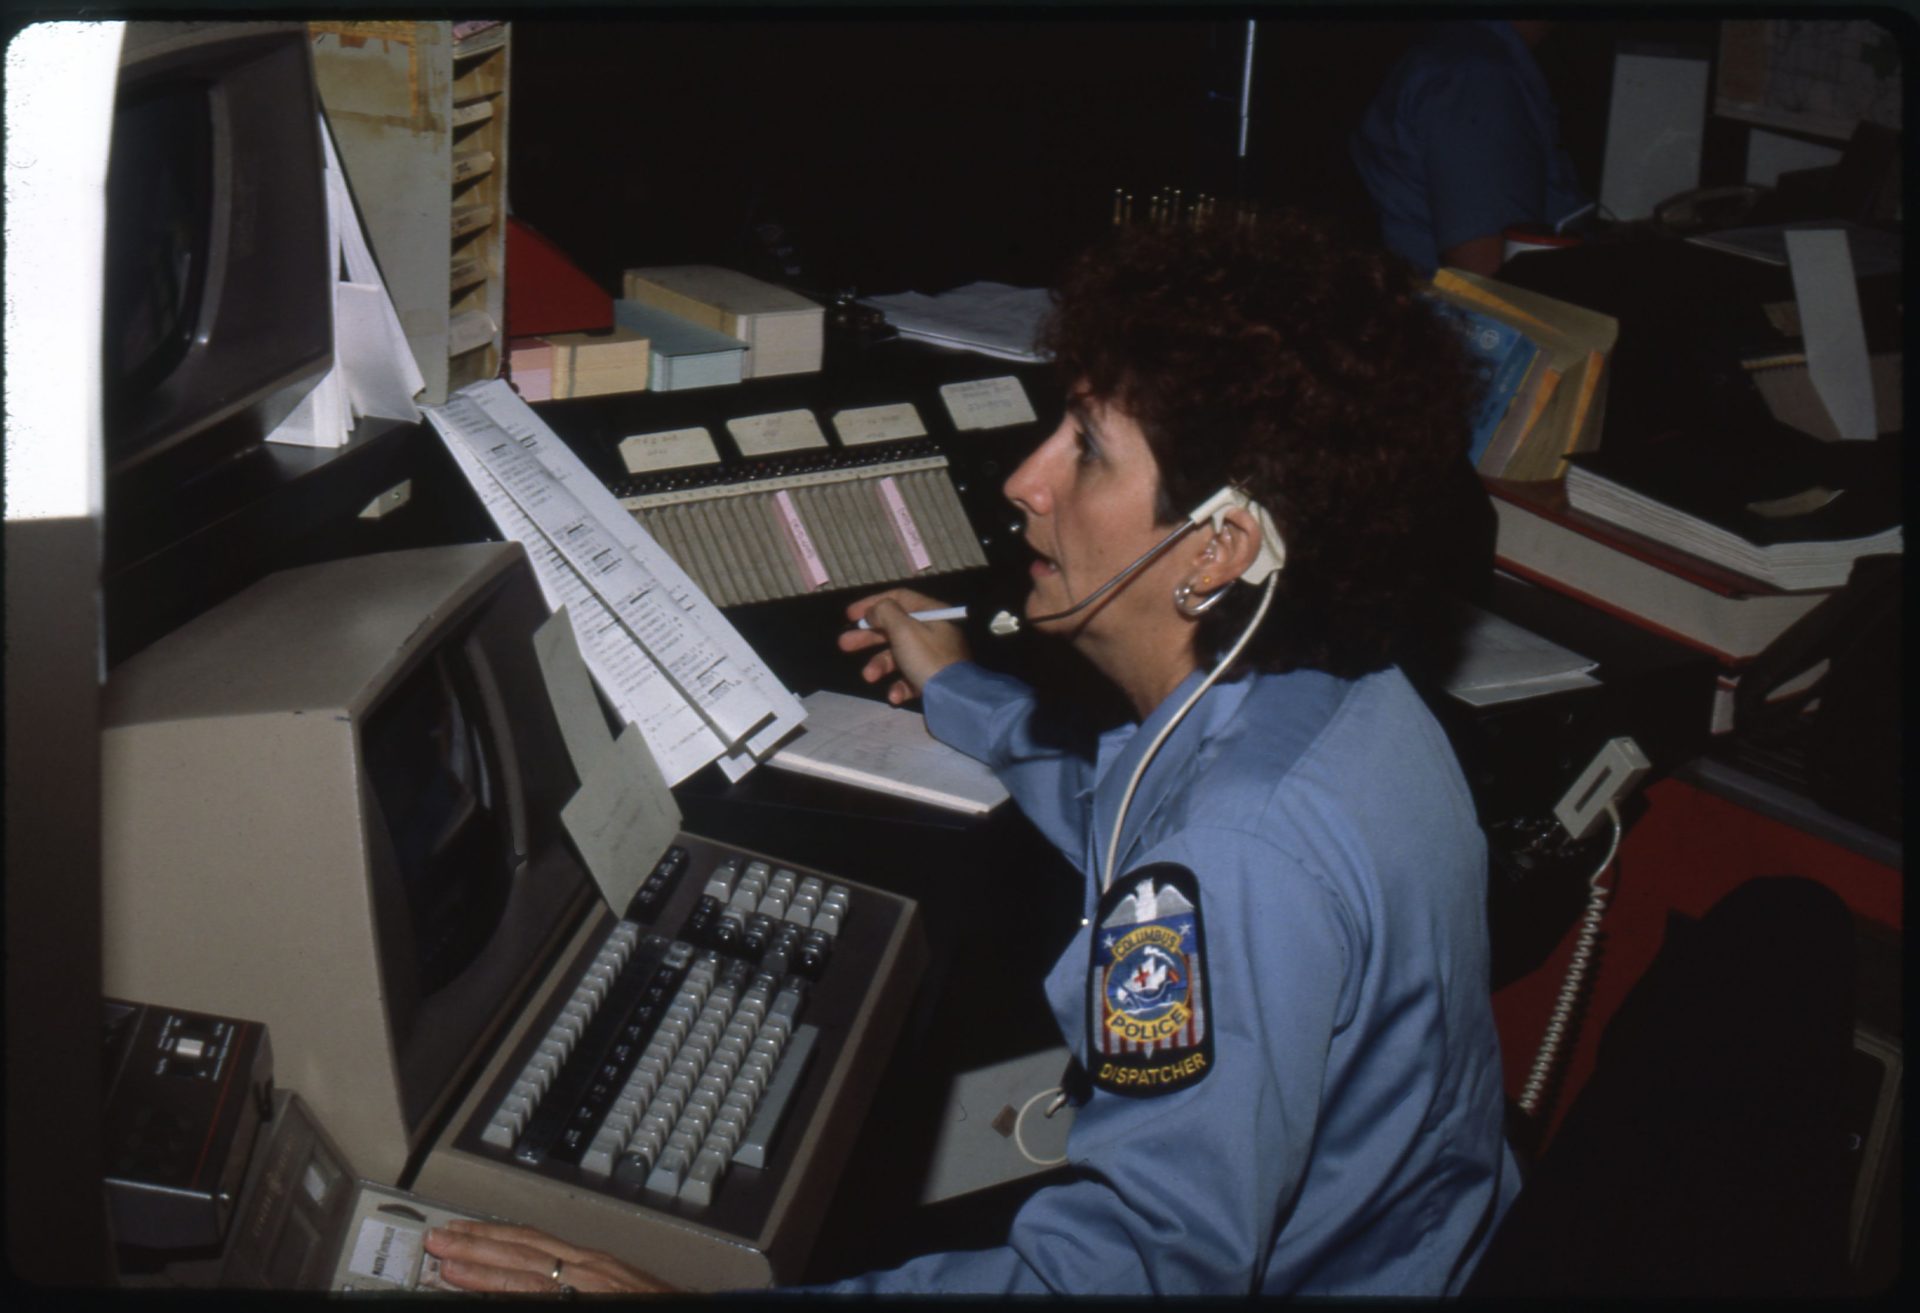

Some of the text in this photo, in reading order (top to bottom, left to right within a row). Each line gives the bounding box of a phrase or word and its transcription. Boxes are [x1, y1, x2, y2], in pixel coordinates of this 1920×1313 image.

[1116, 928, 1177, 955] COLUMBUS
[1111, 1009, 1186, 1039] POLICE
[1100, 1053, 1205, 1084] DISPATCHER
